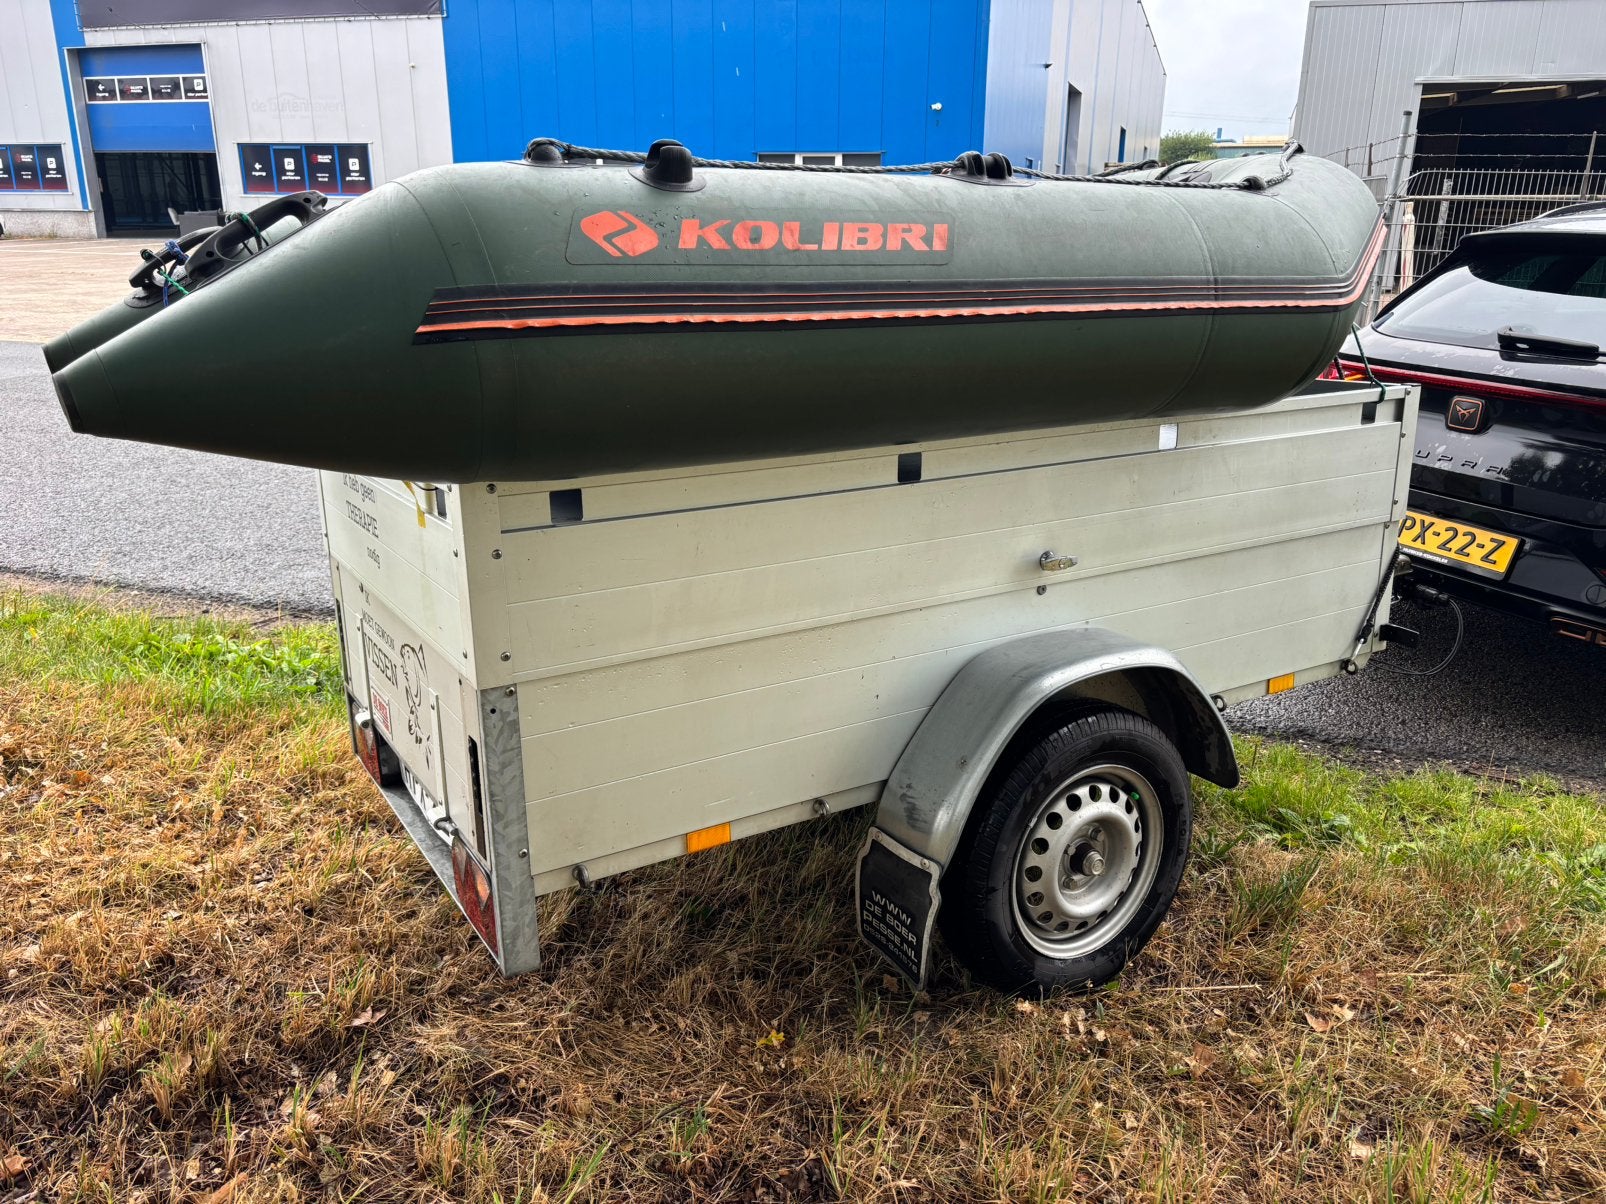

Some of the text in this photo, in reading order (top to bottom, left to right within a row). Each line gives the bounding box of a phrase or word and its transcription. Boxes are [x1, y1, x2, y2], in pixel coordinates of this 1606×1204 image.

[678, 219, 949, 251] KOLIBRI
[1415, 450, 1504, 475] UPRA
[346, 500, 379, 539] THERAPIE
[1398, 516, 1507, 565] PX-22-Z
[363, 631, 399, 690] VISSEN
[865, 900, 917, 946] DE BOER
[872, 890, 912, 926] WWW
[863, 910, 919, 963] PESSE.NL
